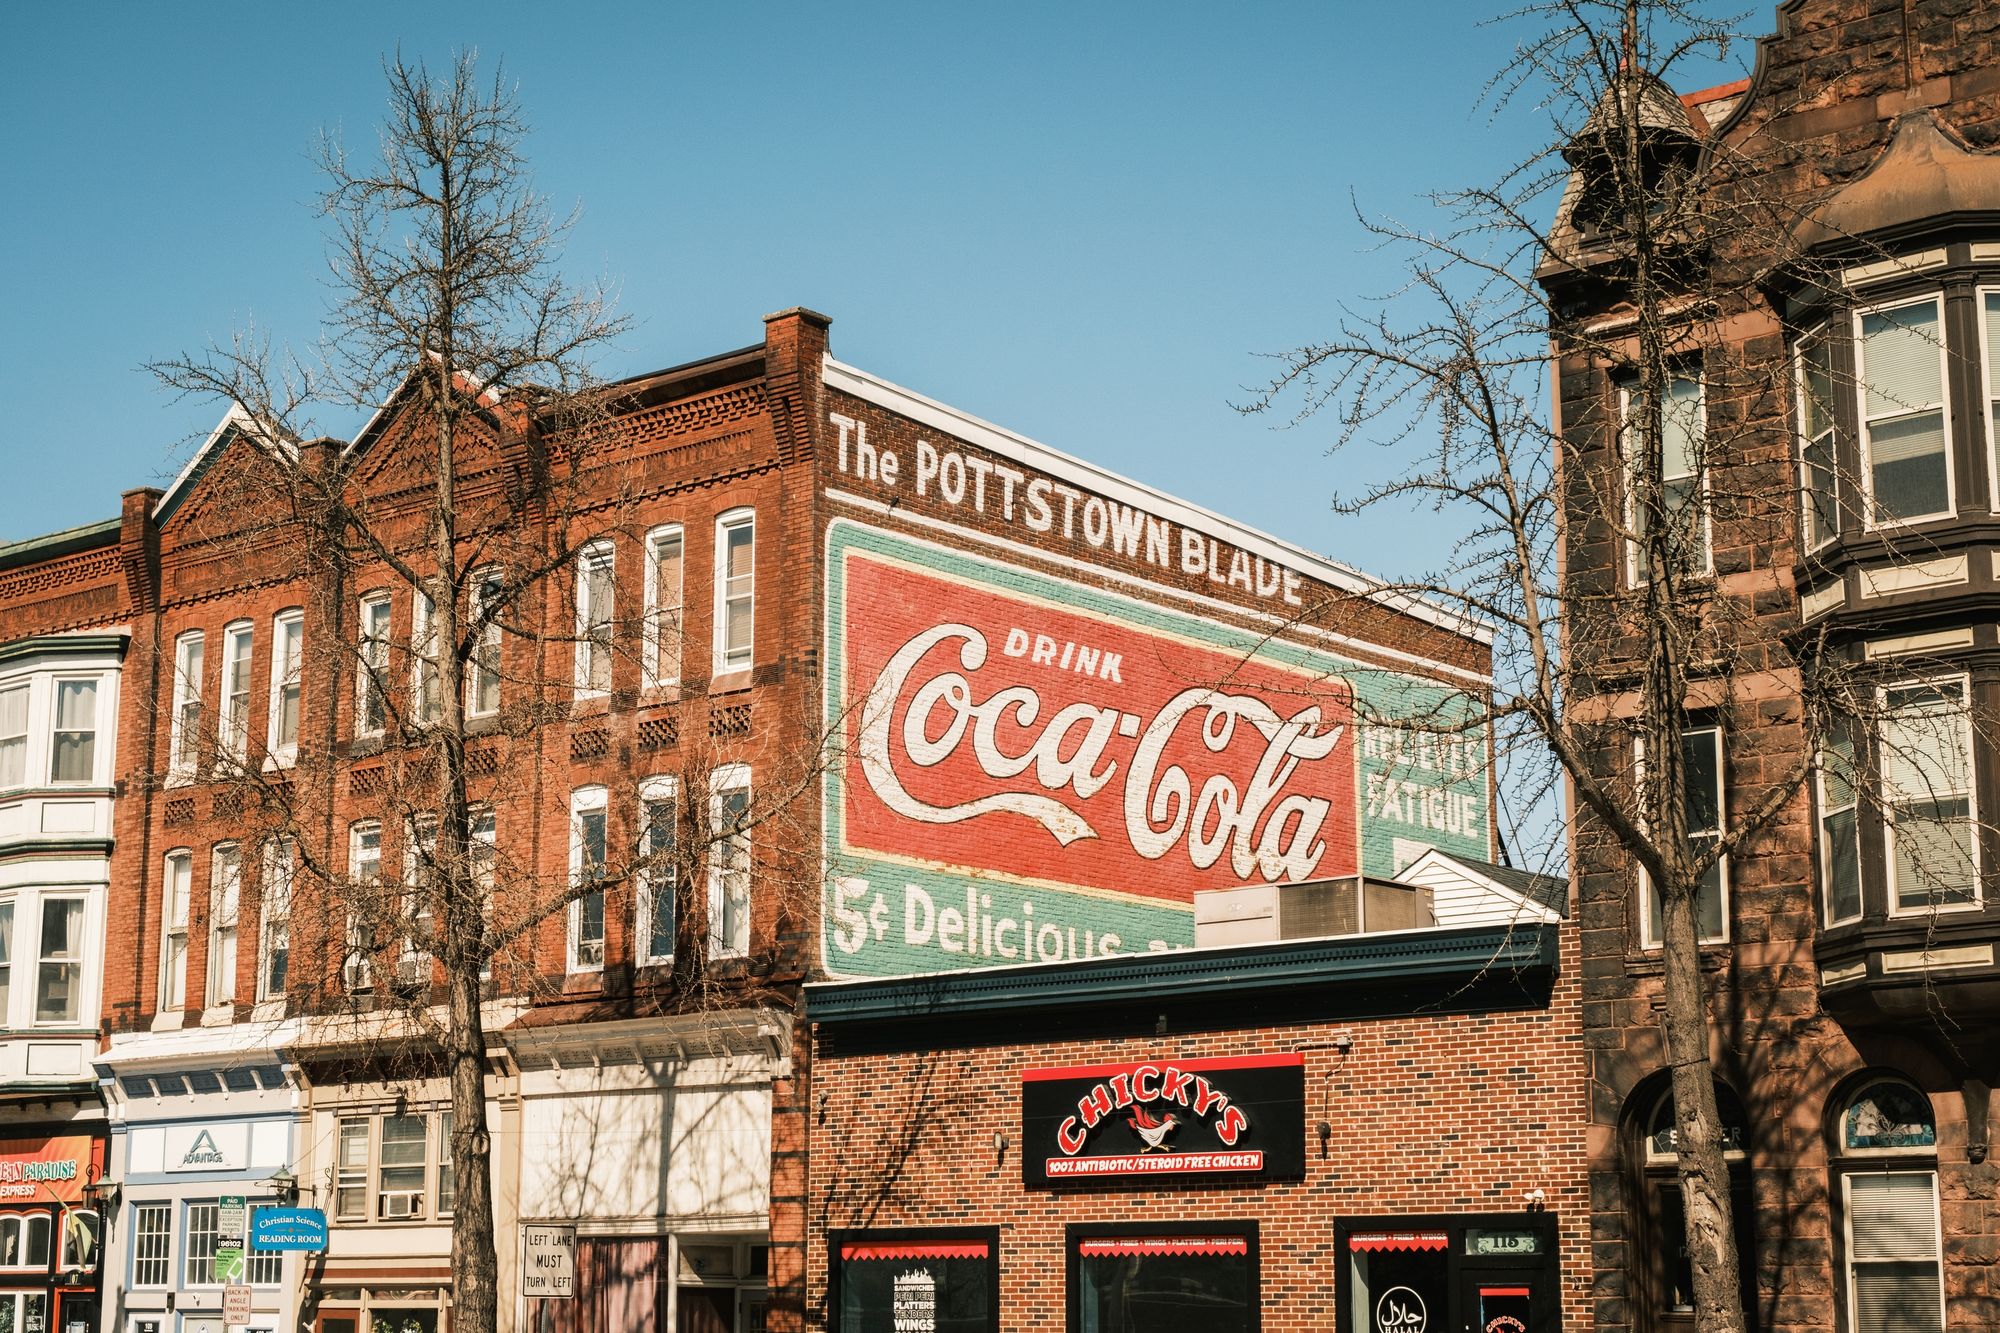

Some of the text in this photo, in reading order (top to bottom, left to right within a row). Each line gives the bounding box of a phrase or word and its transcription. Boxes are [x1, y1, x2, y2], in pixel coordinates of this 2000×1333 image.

[830, 412, 1302, 605] The POTTSTOWN BLADE
[1003, 628, 1123, 684] DRINK
[860, 623, 1345, 883] Coca-Cola
[1367, 772, 1479, 838] FATIGUE
[904, 884, 1123, 962] Delicious
[1058, 1065, 1247, 1155] CHICKY'S
[183, 1152, 223, 1164] ADVANTAGE
[1049, 1155, 1259, 1173] 100% ANTIBIOTIC/STEROID FREE CHICKEN
[0, 1159, 77, 1183] EAN PARADISE
[1, 1185, 36, 1197] EXPRESS
[259, 1215, 323, 1231] Christian Science
[258, 1234, 322, 1243] READING ROOM
[529, 1235, 572, 1246] LEFT LANE
[1353, 1233, 1447, 1242] BURGERS FRIES WINGS
[1493, 1234, 1519, 1248] 115
[536, 1255, 562, 1268] MUST
[526, 1276, 571, 1288] TURN LEFT
[894, 1292, 935, 1301] PERI PERI
[894, 1301, 936, 1310] PLATTERS
[894, 1310, 935, 1319] TENDERS
[1381, 1299, 1422, 1326] حلال
[894, 1319, 936, 1331] WINGS
